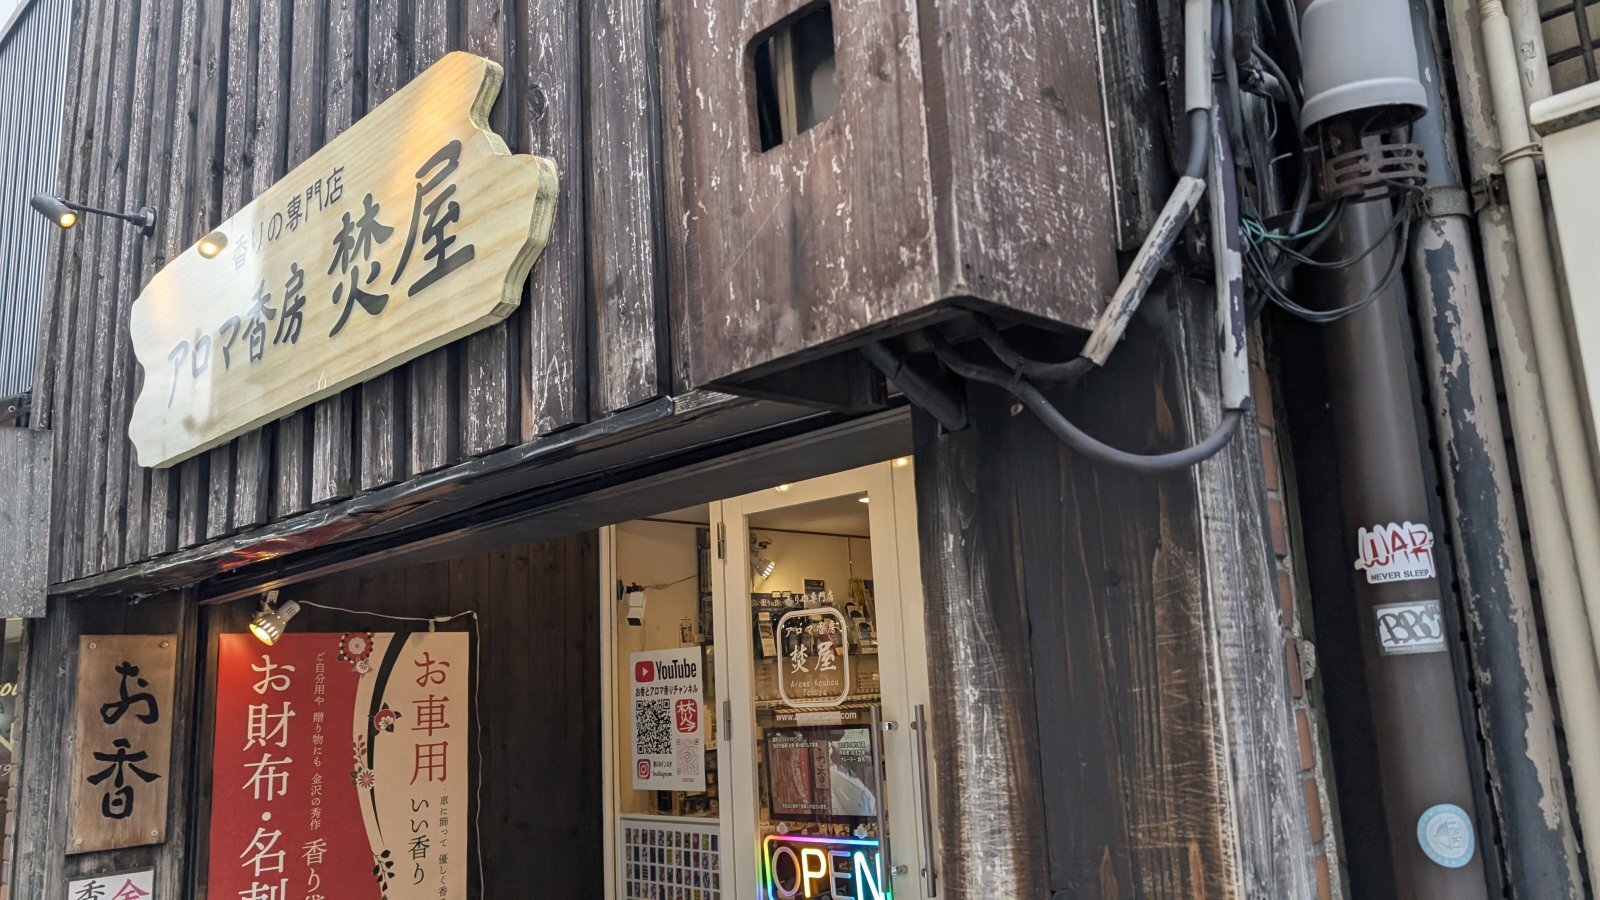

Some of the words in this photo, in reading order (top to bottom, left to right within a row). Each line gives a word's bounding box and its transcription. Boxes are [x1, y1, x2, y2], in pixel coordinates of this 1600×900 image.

[233, 165, 346, 270] 香りの専門店
[166, 261, 307, 409] アロマ香房
[328, 138, 476, 339] 焚屋
[1370, 571, 1401, 581] NEVER
[1404, 569, 1430, 578] SLEEP
[313, 652, 325, 705] ご自分用や
[655, 658, 697, 681] YouTube
[789, 641, 837, 674] 焚屋
[409, 650, 451, 786] お車用
[636, 685, 698, 697] お香とアロマ香りチャンネル
[87, 660, 162, 820] お香
[311, 712, 324, 767] 贈り物にも
[309, 773, 323, 831] 金沢の秀作
[439, 795, 449, 848] 車に飾って
[301, 837, 328, 900] 香り
[408, 798, 431, 885] いい香り
[772, 846, 886, 900] OPEN
